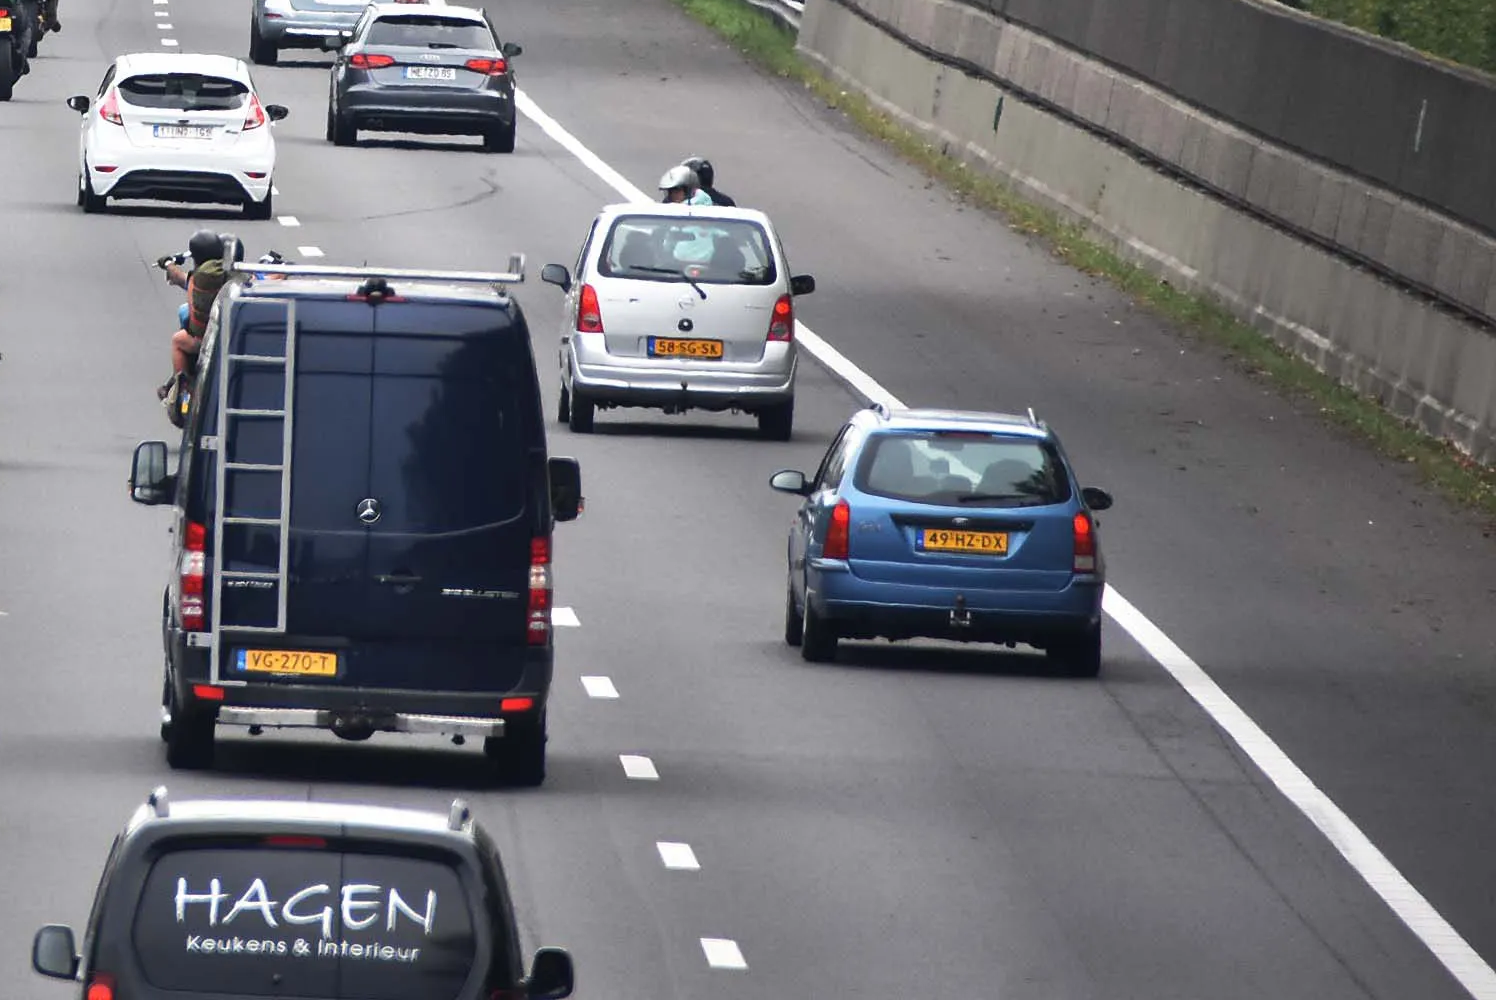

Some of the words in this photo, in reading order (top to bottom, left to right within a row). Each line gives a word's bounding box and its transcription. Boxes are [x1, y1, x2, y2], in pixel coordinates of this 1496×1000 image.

[252, 652, 329, 671] VG-270-T
[173, 876, 437, 940] HAGEN
[186, 934, 287, 955] Keukens
[292, 938, 312, 957] &
[317, 937, 421, 963] Interieur
